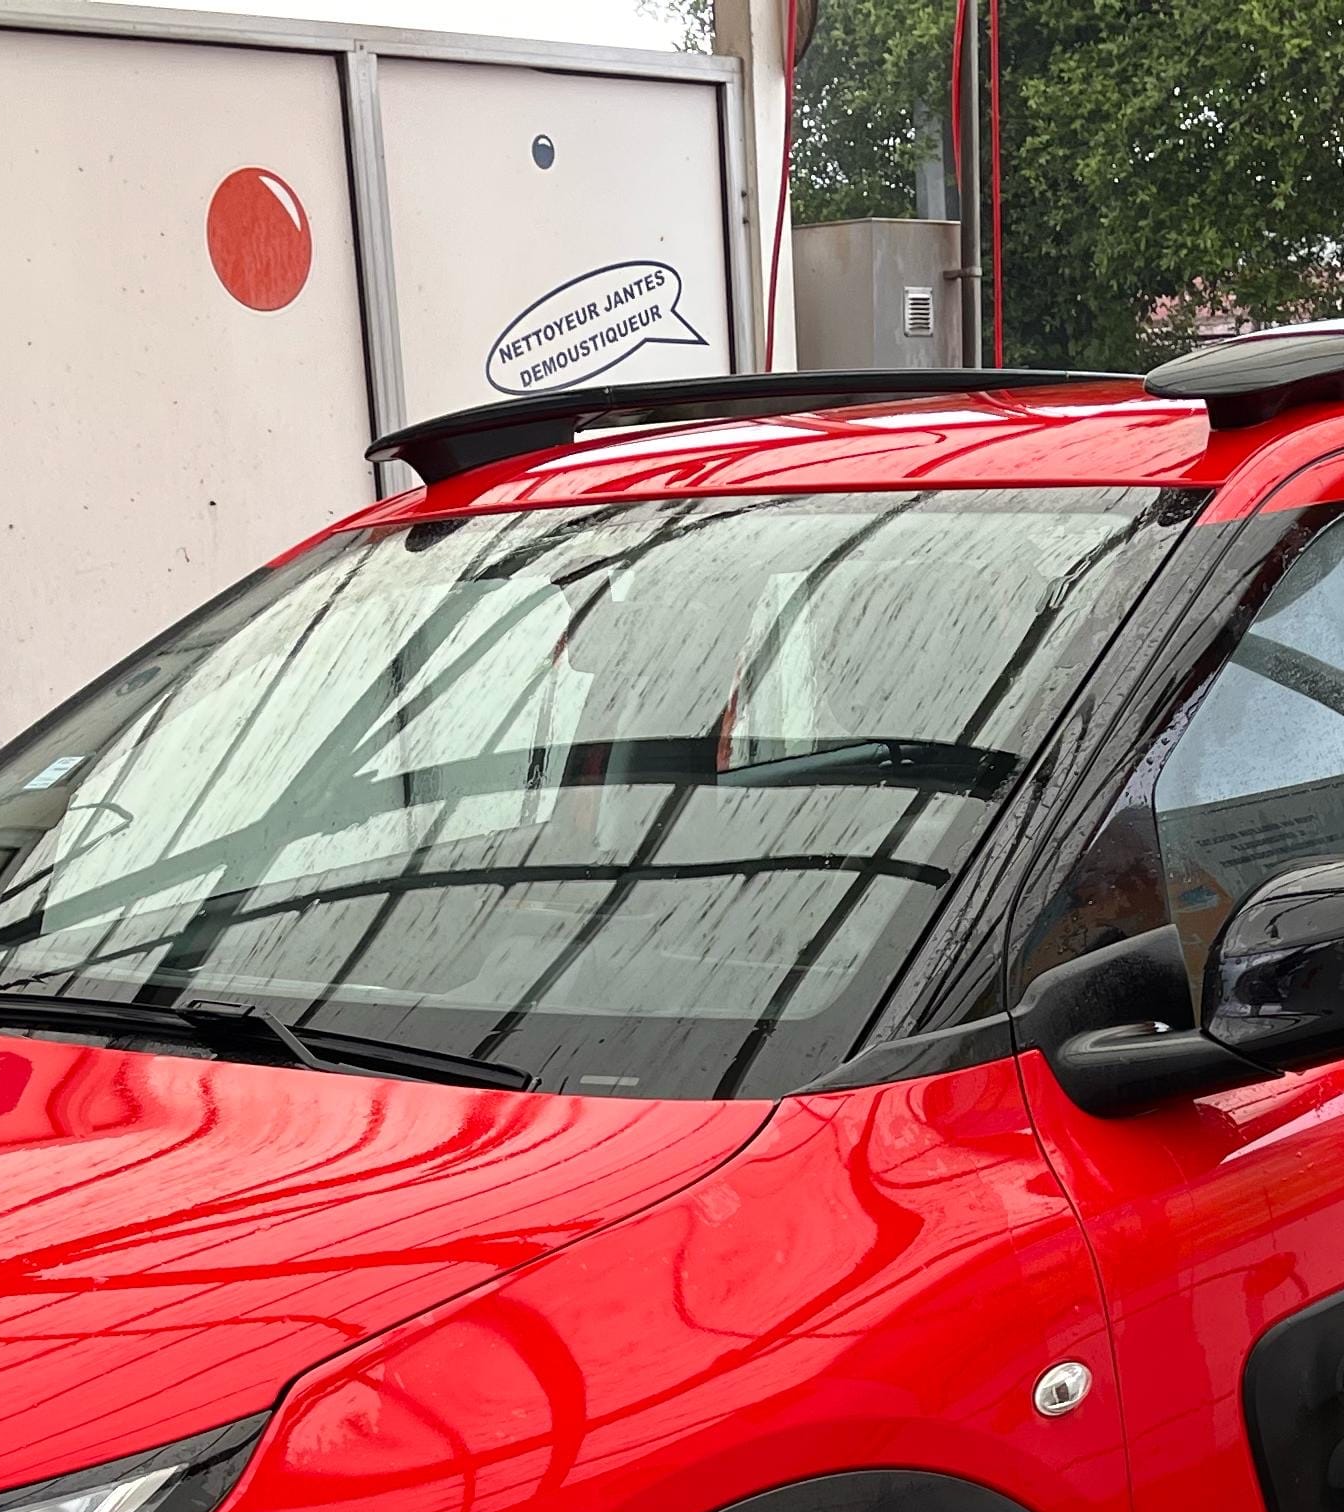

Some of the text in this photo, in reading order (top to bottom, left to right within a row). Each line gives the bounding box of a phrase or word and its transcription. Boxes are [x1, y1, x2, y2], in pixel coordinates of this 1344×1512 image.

[498, 269, 666, 364] NETTOYEUR JANTES
[519, 304, 663, 388] DEMOUSTIQUEUR
